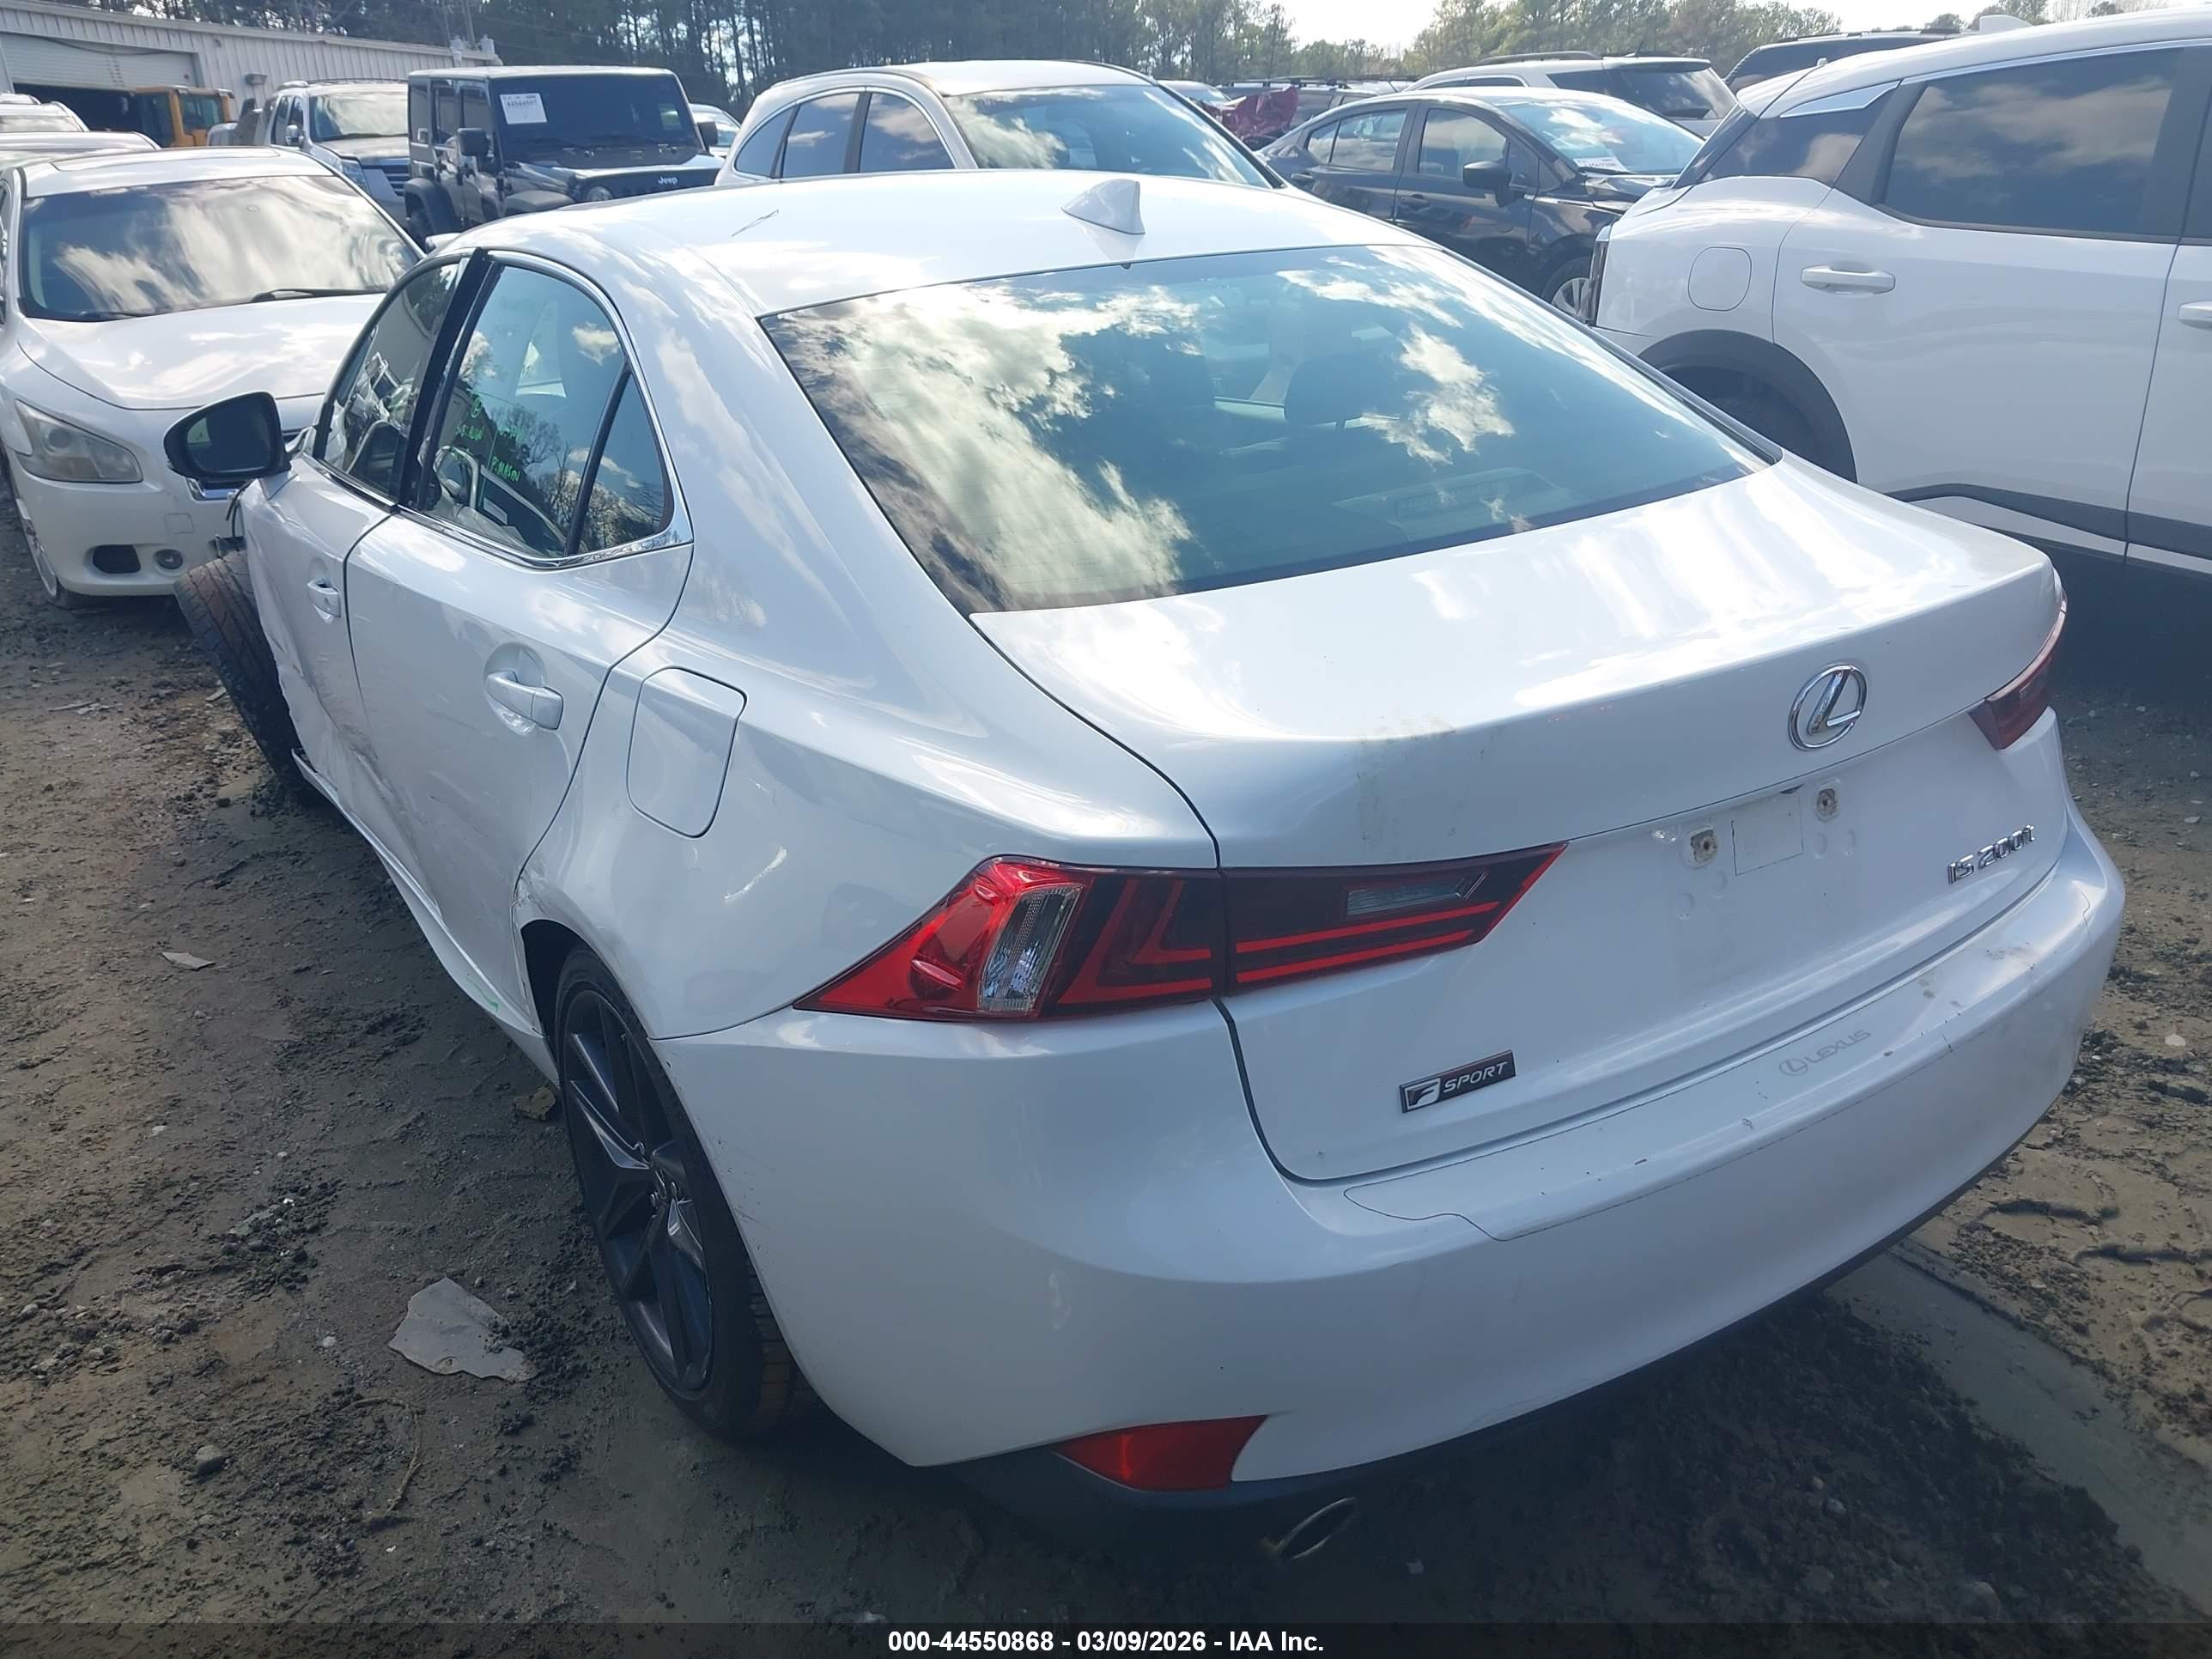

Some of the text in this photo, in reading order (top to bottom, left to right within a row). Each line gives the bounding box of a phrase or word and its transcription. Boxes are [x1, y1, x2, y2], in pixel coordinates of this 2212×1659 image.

[658, 176, 678, 186] Jeep
[1947, 824, 2034, 884] IS 200t
[1806, 1030, 1871, 1064] LEXUS
[1443, 1061, 1508, 1093] SPORT
